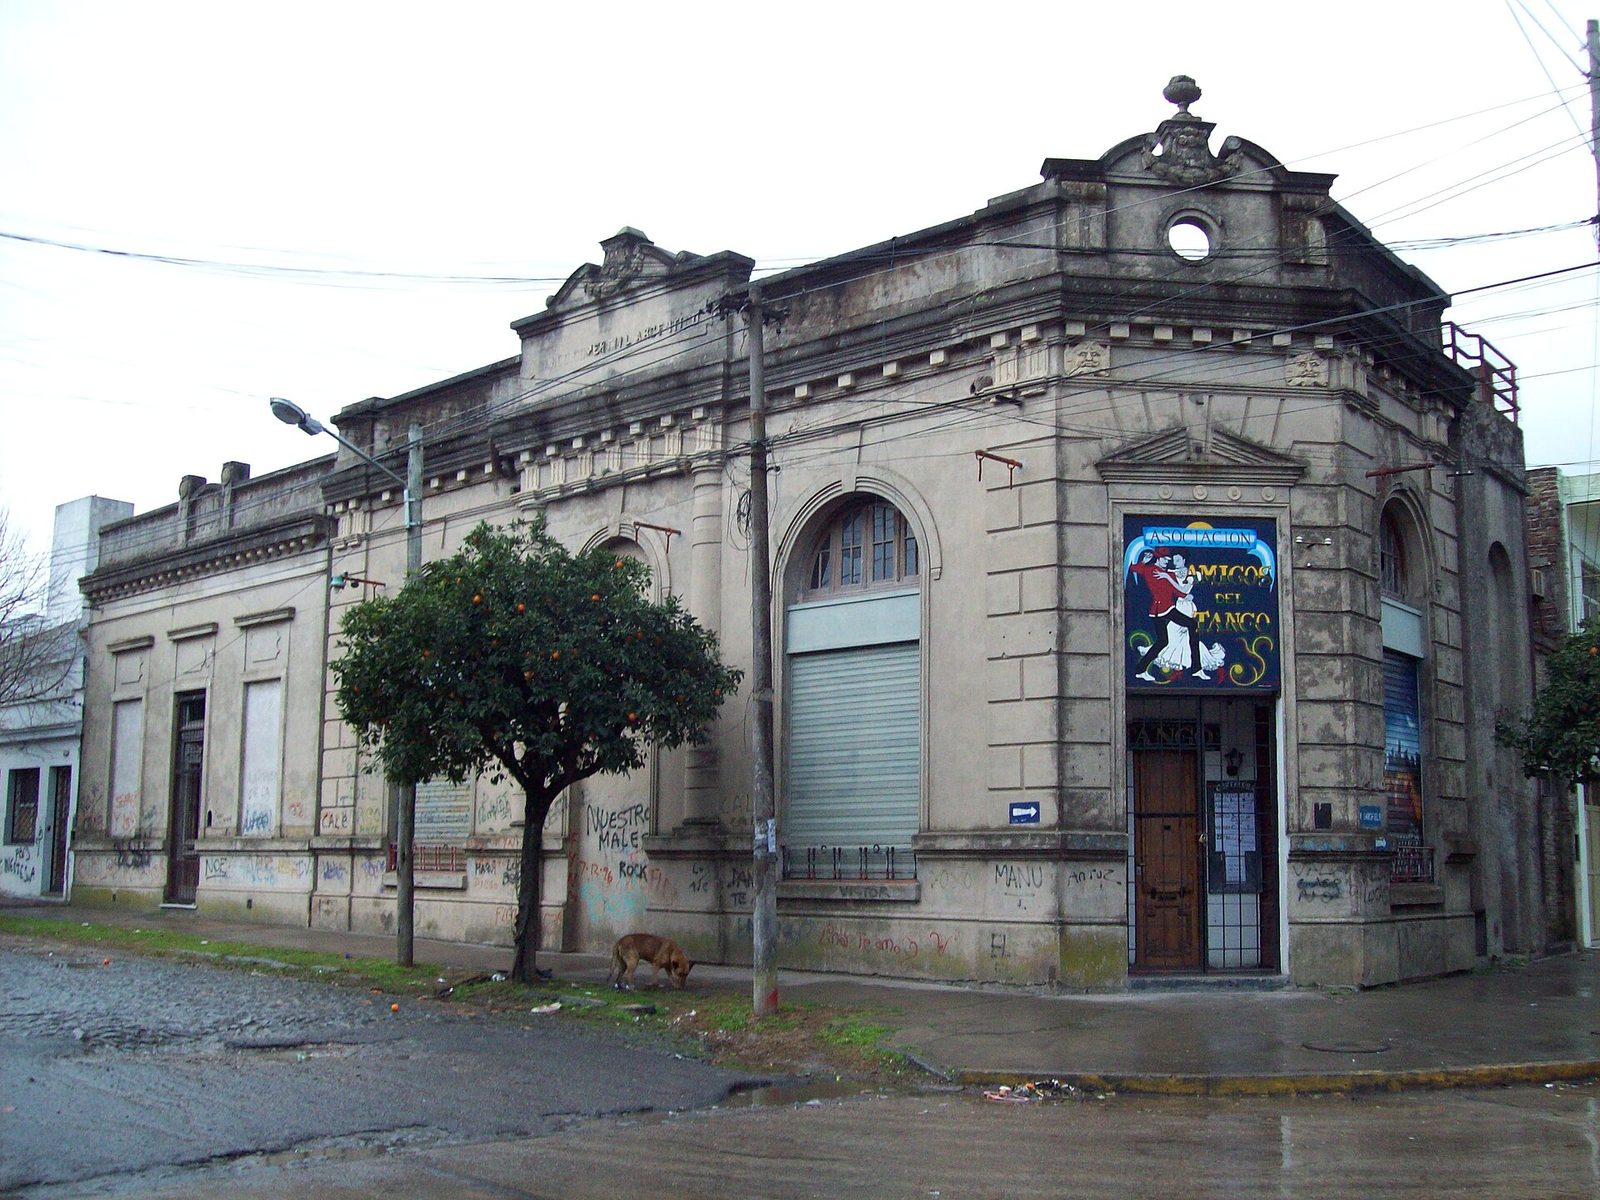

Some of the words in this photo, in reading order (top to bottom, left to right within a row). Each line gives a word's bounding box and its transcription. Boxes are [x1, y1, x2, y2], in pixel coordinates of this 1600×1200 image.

[1149, 529, 1251, 546] ASOCIACION
[1183, 564, 1272, 586] AMIGOS
[1214, 593, 1244, 605] DEL
[1193, 611, 1271, 633] TANGO
[619, 861, 648, 882] ROCK
[995, 864, 1043, 889] MANU
